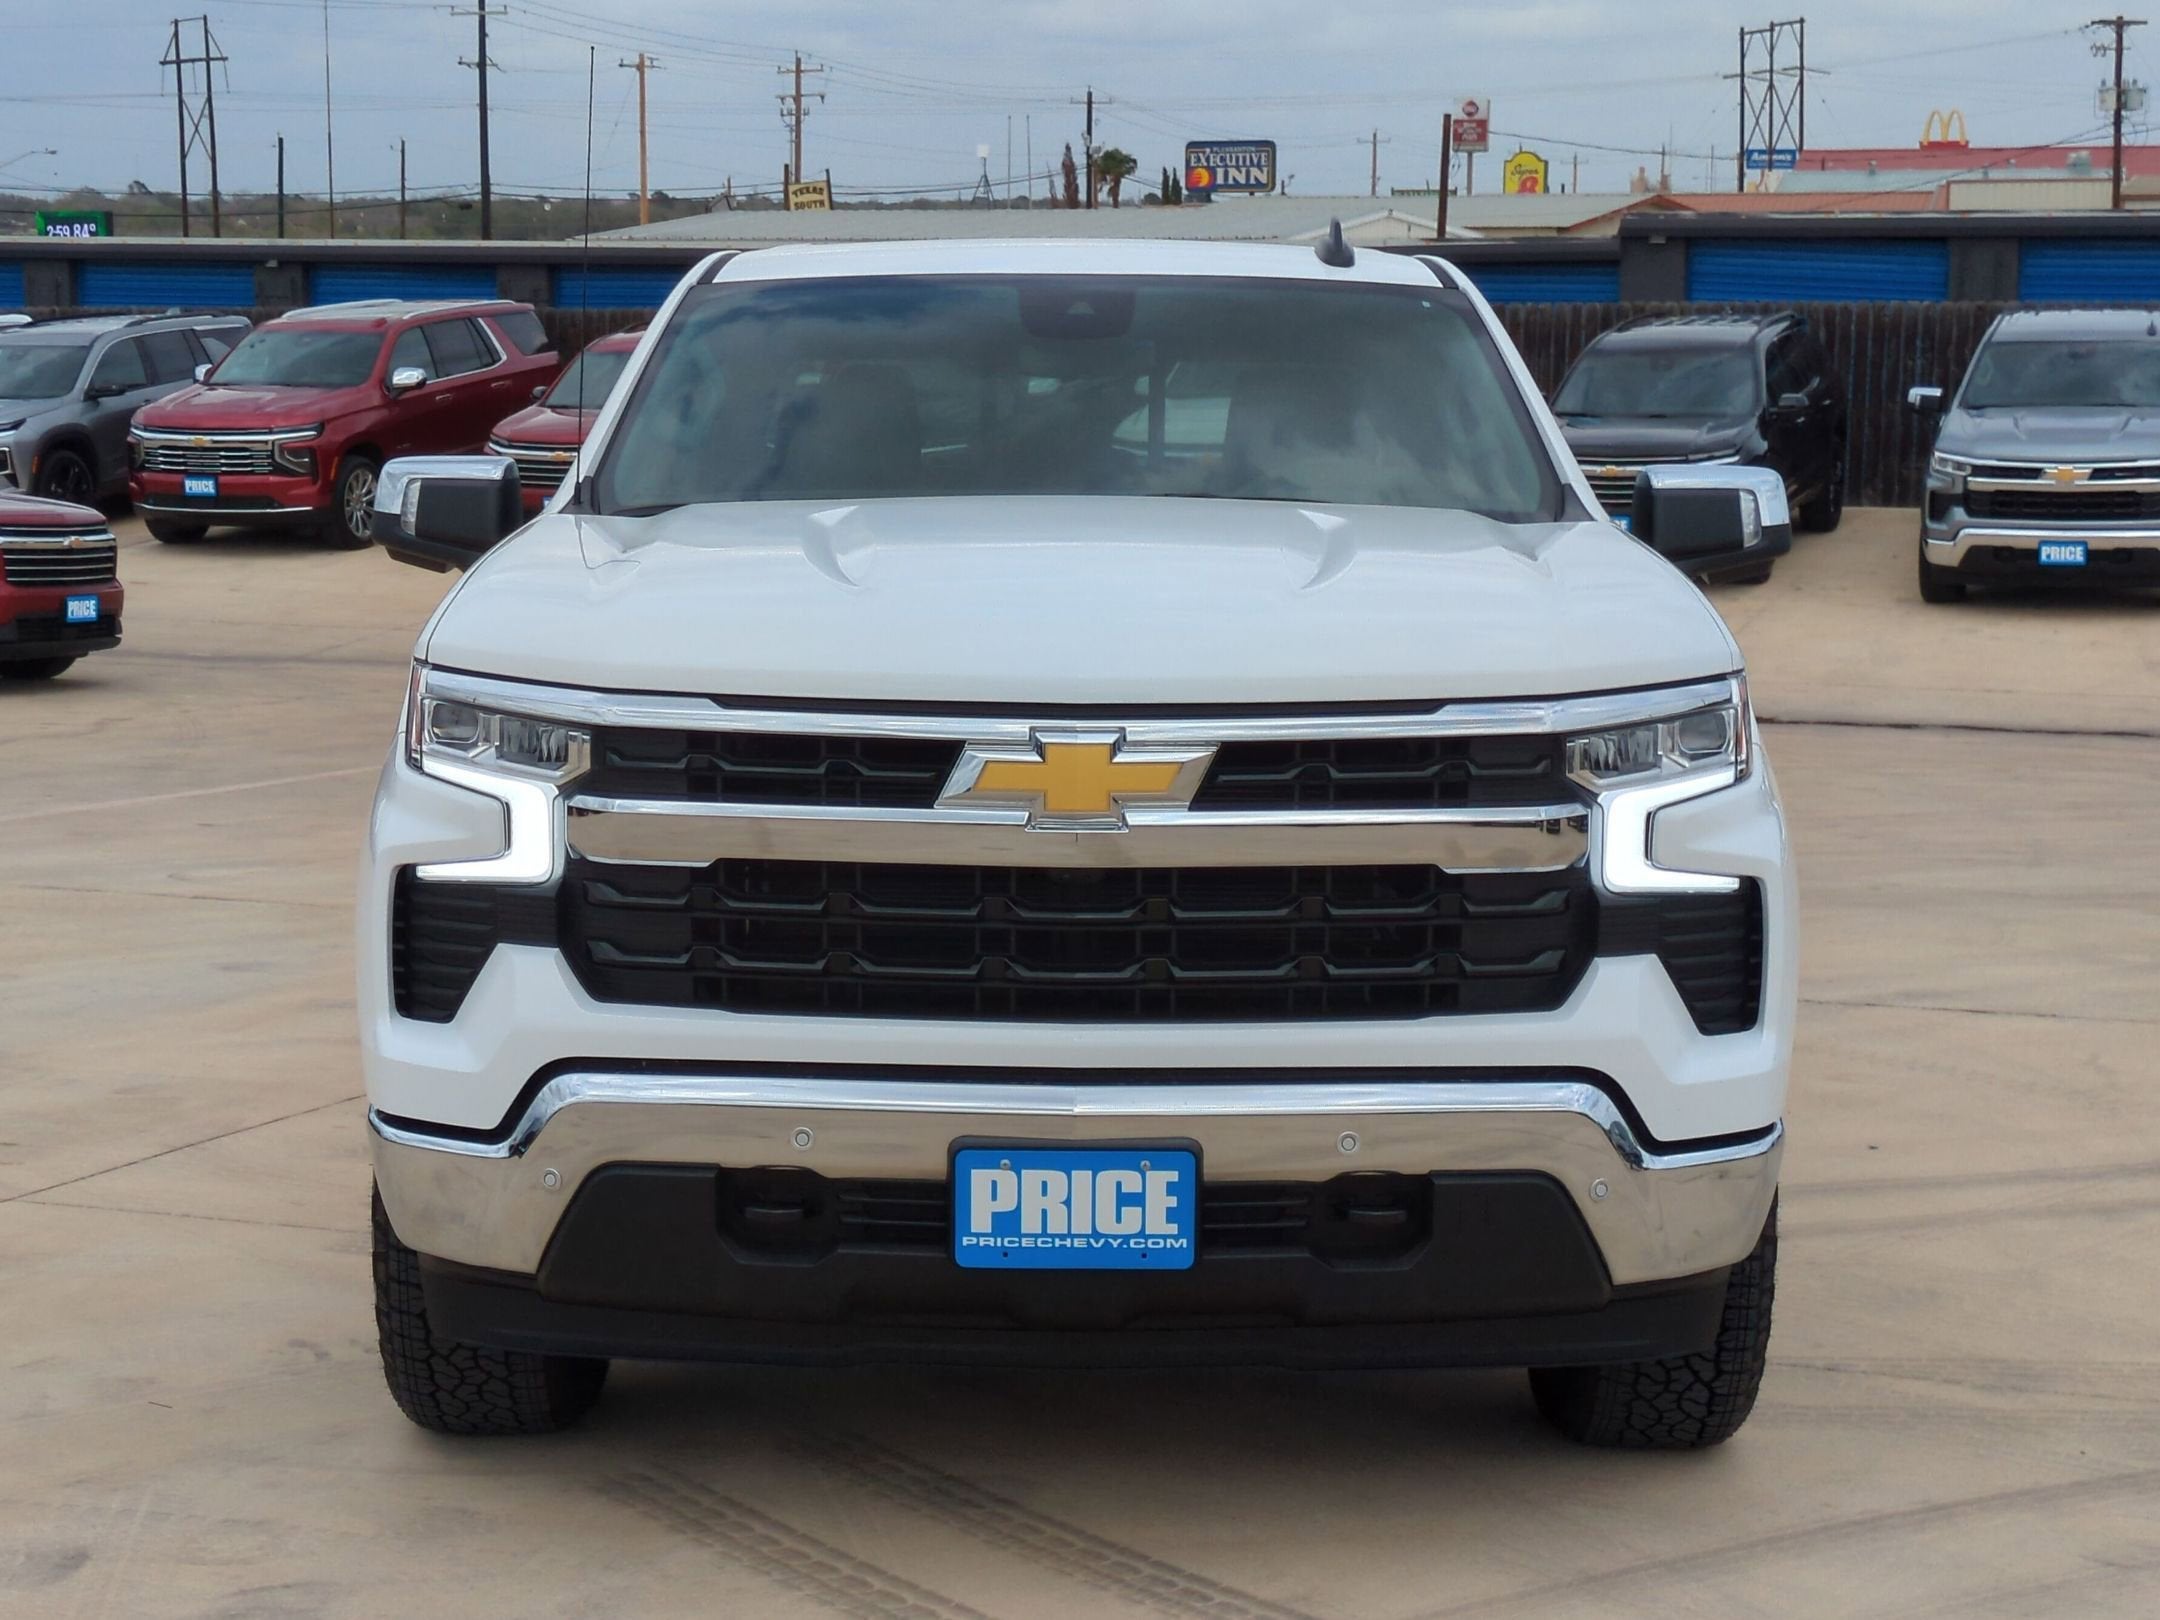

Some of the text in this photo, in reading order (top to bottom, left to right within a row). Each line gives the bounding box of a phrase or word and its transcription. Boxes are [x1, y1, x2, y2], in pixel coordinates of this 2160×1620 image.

[1190, 148, 1268, 167] EXECUTIVE
[1215, 167, 1268, 185] INN
[791, 185, 824, 198] TEXAS
[793, 199, 825, 210] SOUTH
[184, 480, 215, 492] PRICE
[2041, 546, 2084, 560] PRICE
[67, 600, 96, 616] PRICE
[970, 1168, 1179, 1235] PRICE
[962, 1236, 1187, 1249] PRICECHEVY.COM
